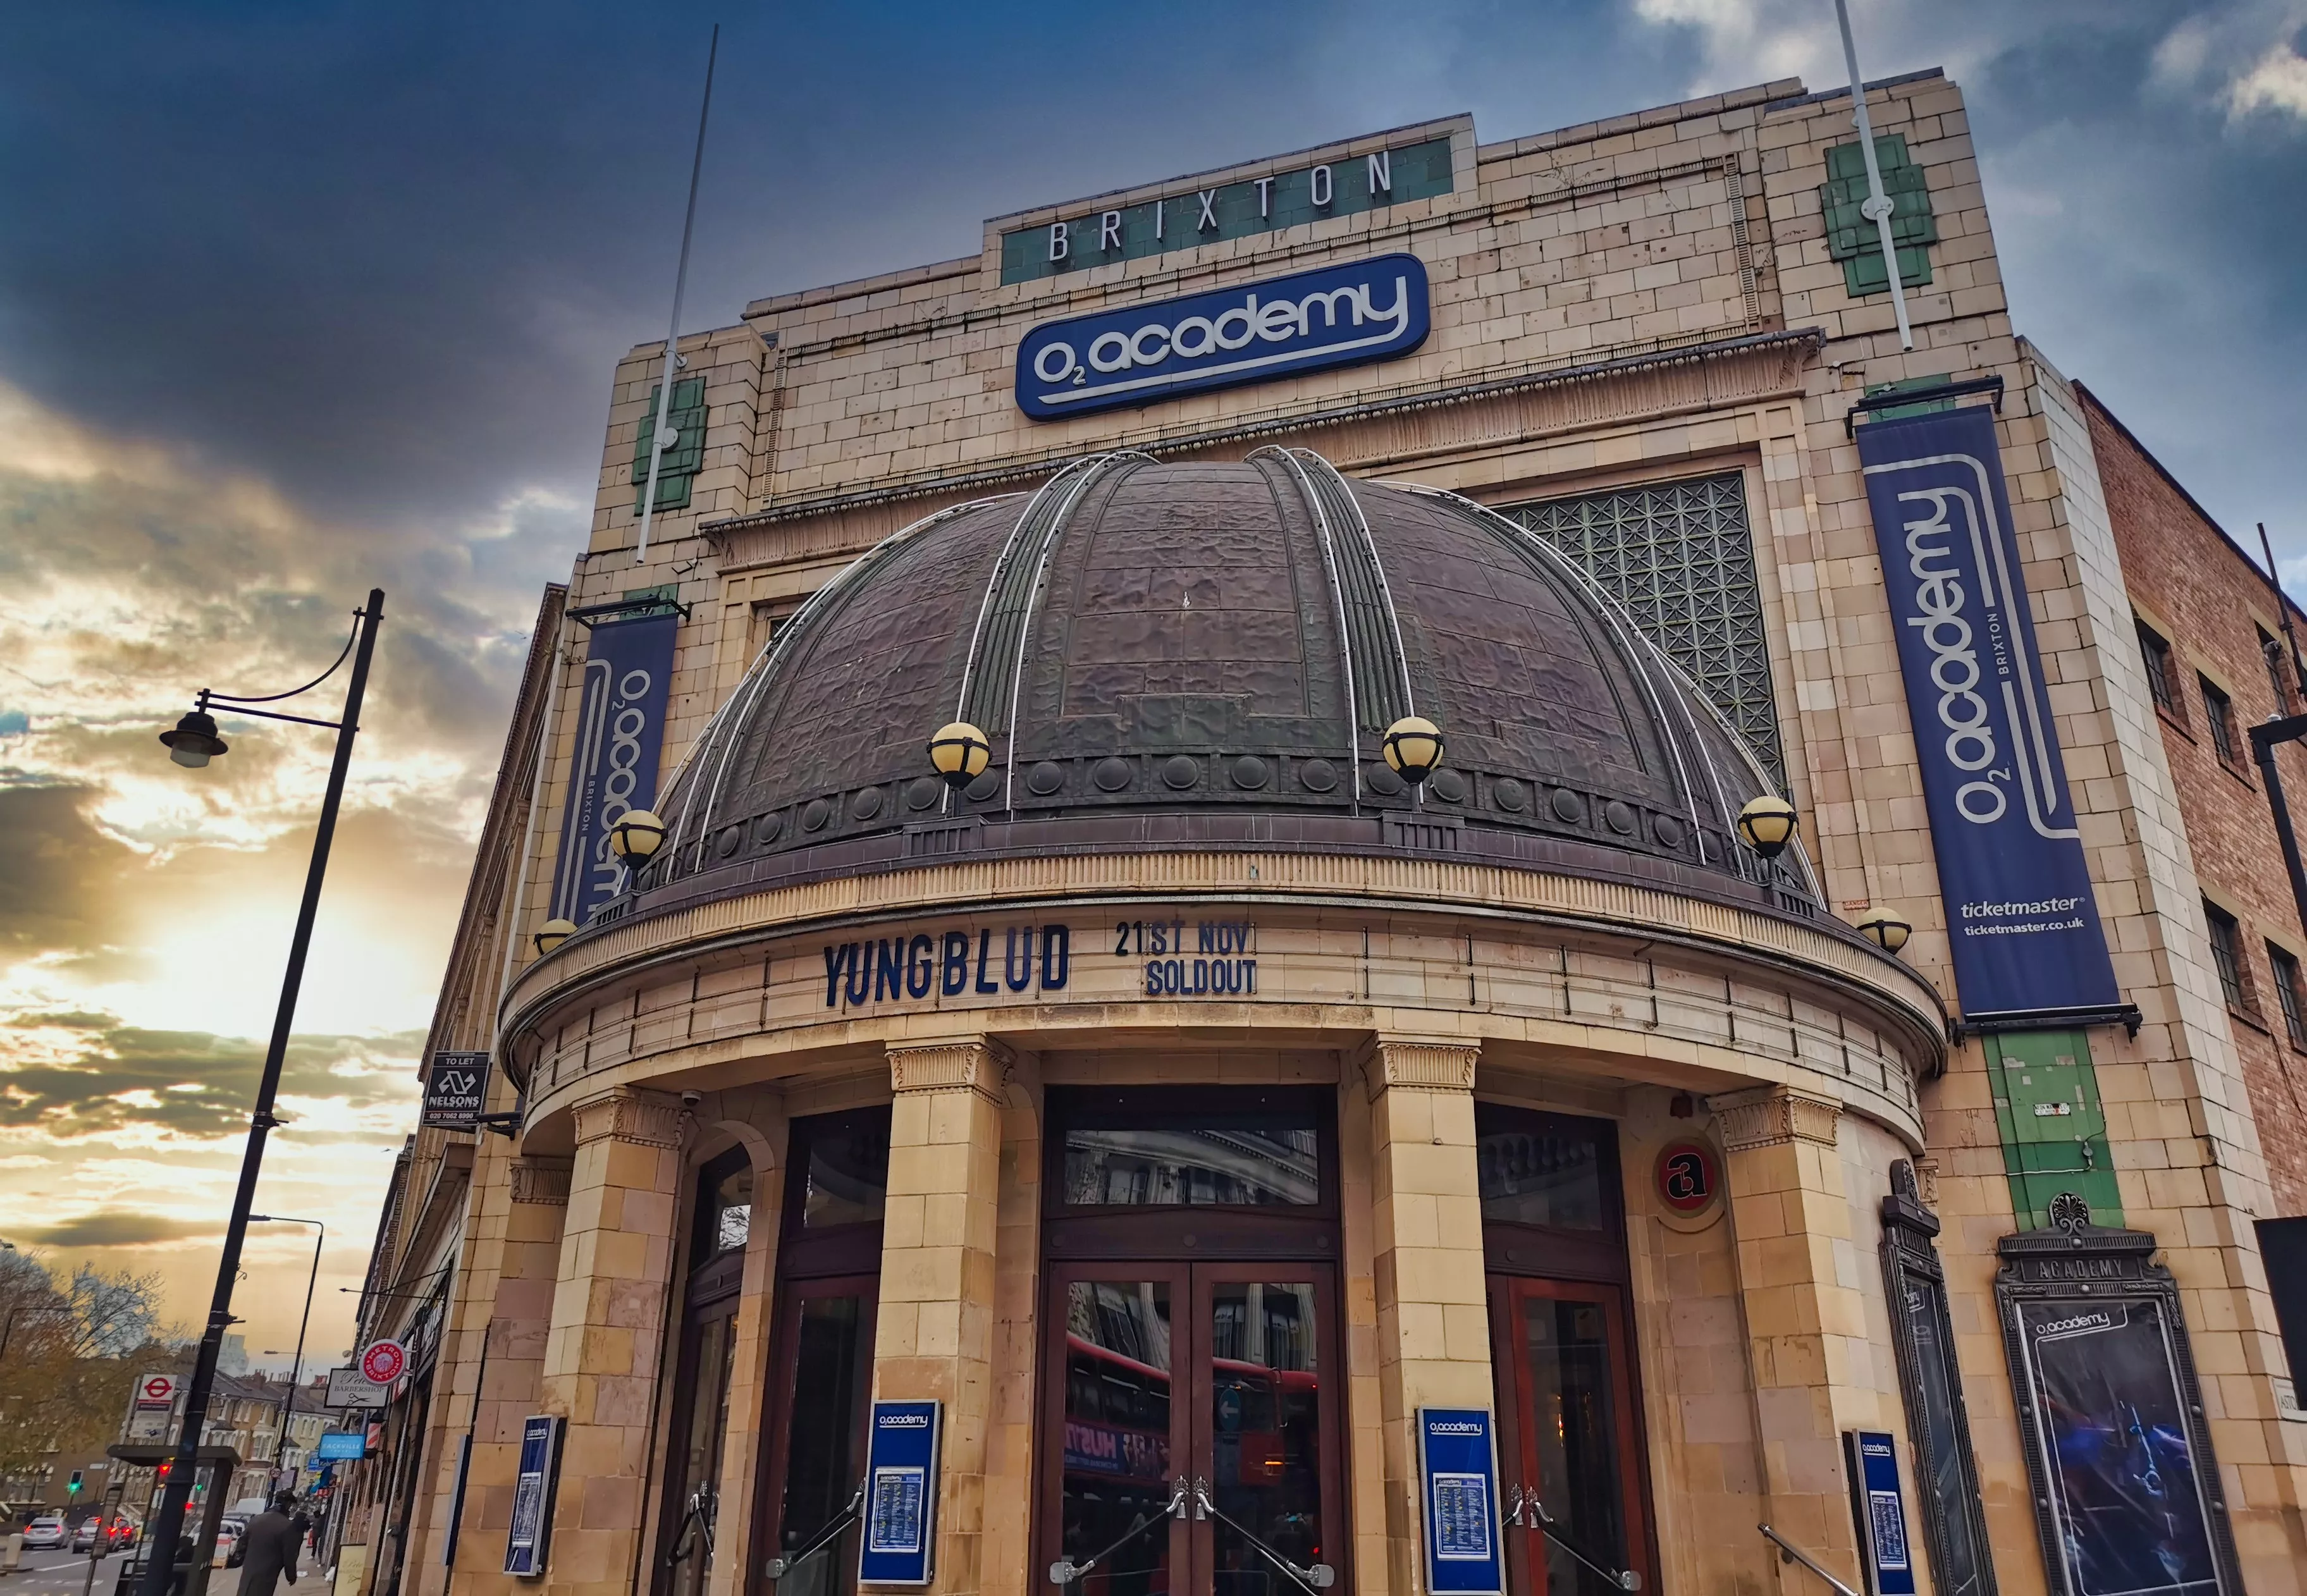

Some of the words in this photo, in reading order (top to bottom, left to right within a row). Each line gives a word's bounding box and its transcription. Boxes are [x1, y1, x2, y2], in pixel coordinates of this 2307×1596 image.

[1049, 150, 1391, 262] BRIXTON
[1088, 276, 1408, 372] academy
[1898, 486, 1996, 771] academy
[1986, 612, 2009, 675] BRIXTON
[582, 780, 596, 832] BRIXTON
[1964, 917, 2085, 936] ticketmaster.co.uk
[1116, 920, 1186, 956] 21ST
[1198, 921, 1250, 955] NOV
[428, 1096, 479, 1107] NELSONS
[2039, 1258, 2122, 1279] ACADEMY
[2047, 1312, 2110, 1332] academy
[369, 1346, 400, 1360] METRO
[366, 1361, 402, 1380] BRIXTON
[887, 1414, 928, 1426] academy
[1437, 1421, 1482, 1433] academy
